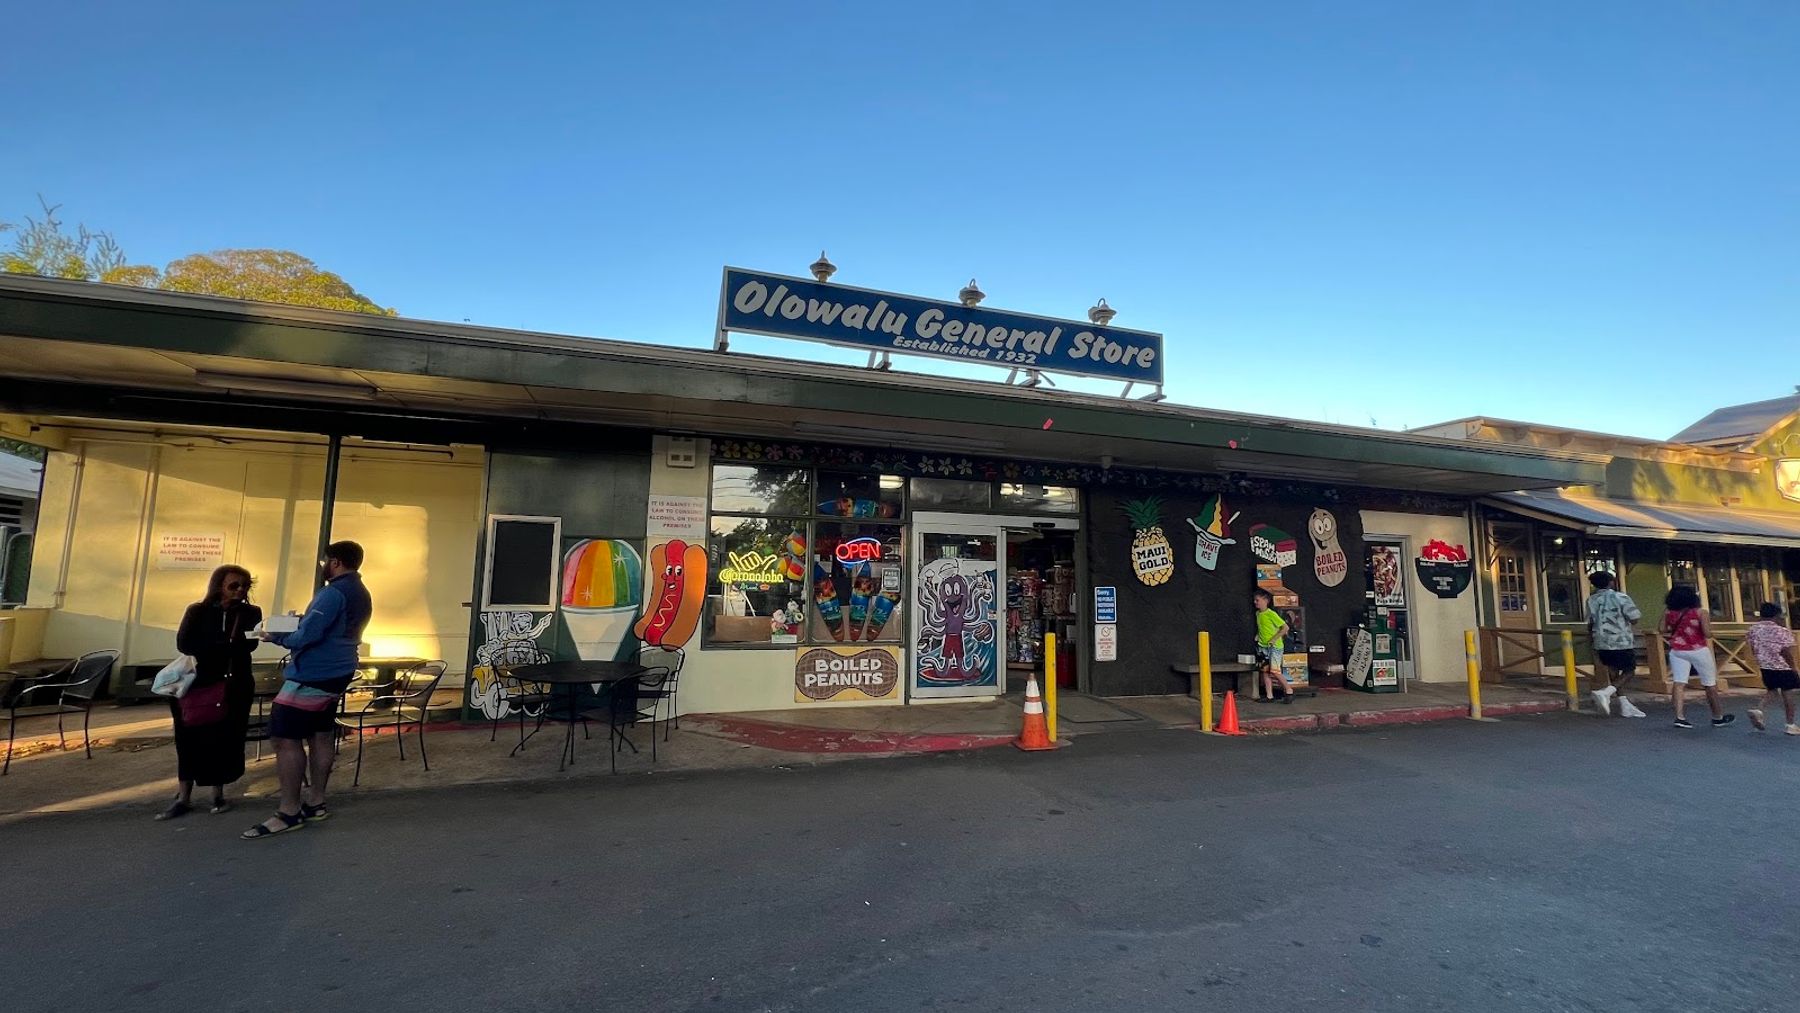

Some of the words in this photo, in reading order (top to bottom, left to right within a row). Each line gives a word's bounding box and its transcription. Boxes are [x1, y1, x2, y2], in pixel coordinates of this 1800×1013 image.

[734, 281, 909, 335] Olowalu
[915, 308, 1063, 355] General
[1067, 331, 1155, 368] Store
[893, 335, 990, 359] Established
[995, 350, 1037, 365] 1932
[1254, 536, 1276, 552] SPAM
[836, 543, 881, 560] OPEN
[1136, 546, 1166, 560] MAUI
[1201, 550, 1211, 560] ICE
[1139, 558, 1168, 570] GOLD
[1316, 552, 1344, 566] BOILED
[1317, 562, 1346, 576] PEANUTS
[815, 659, 882, 672] BOILED
[804, 672, 884, 688] PEANUTS
